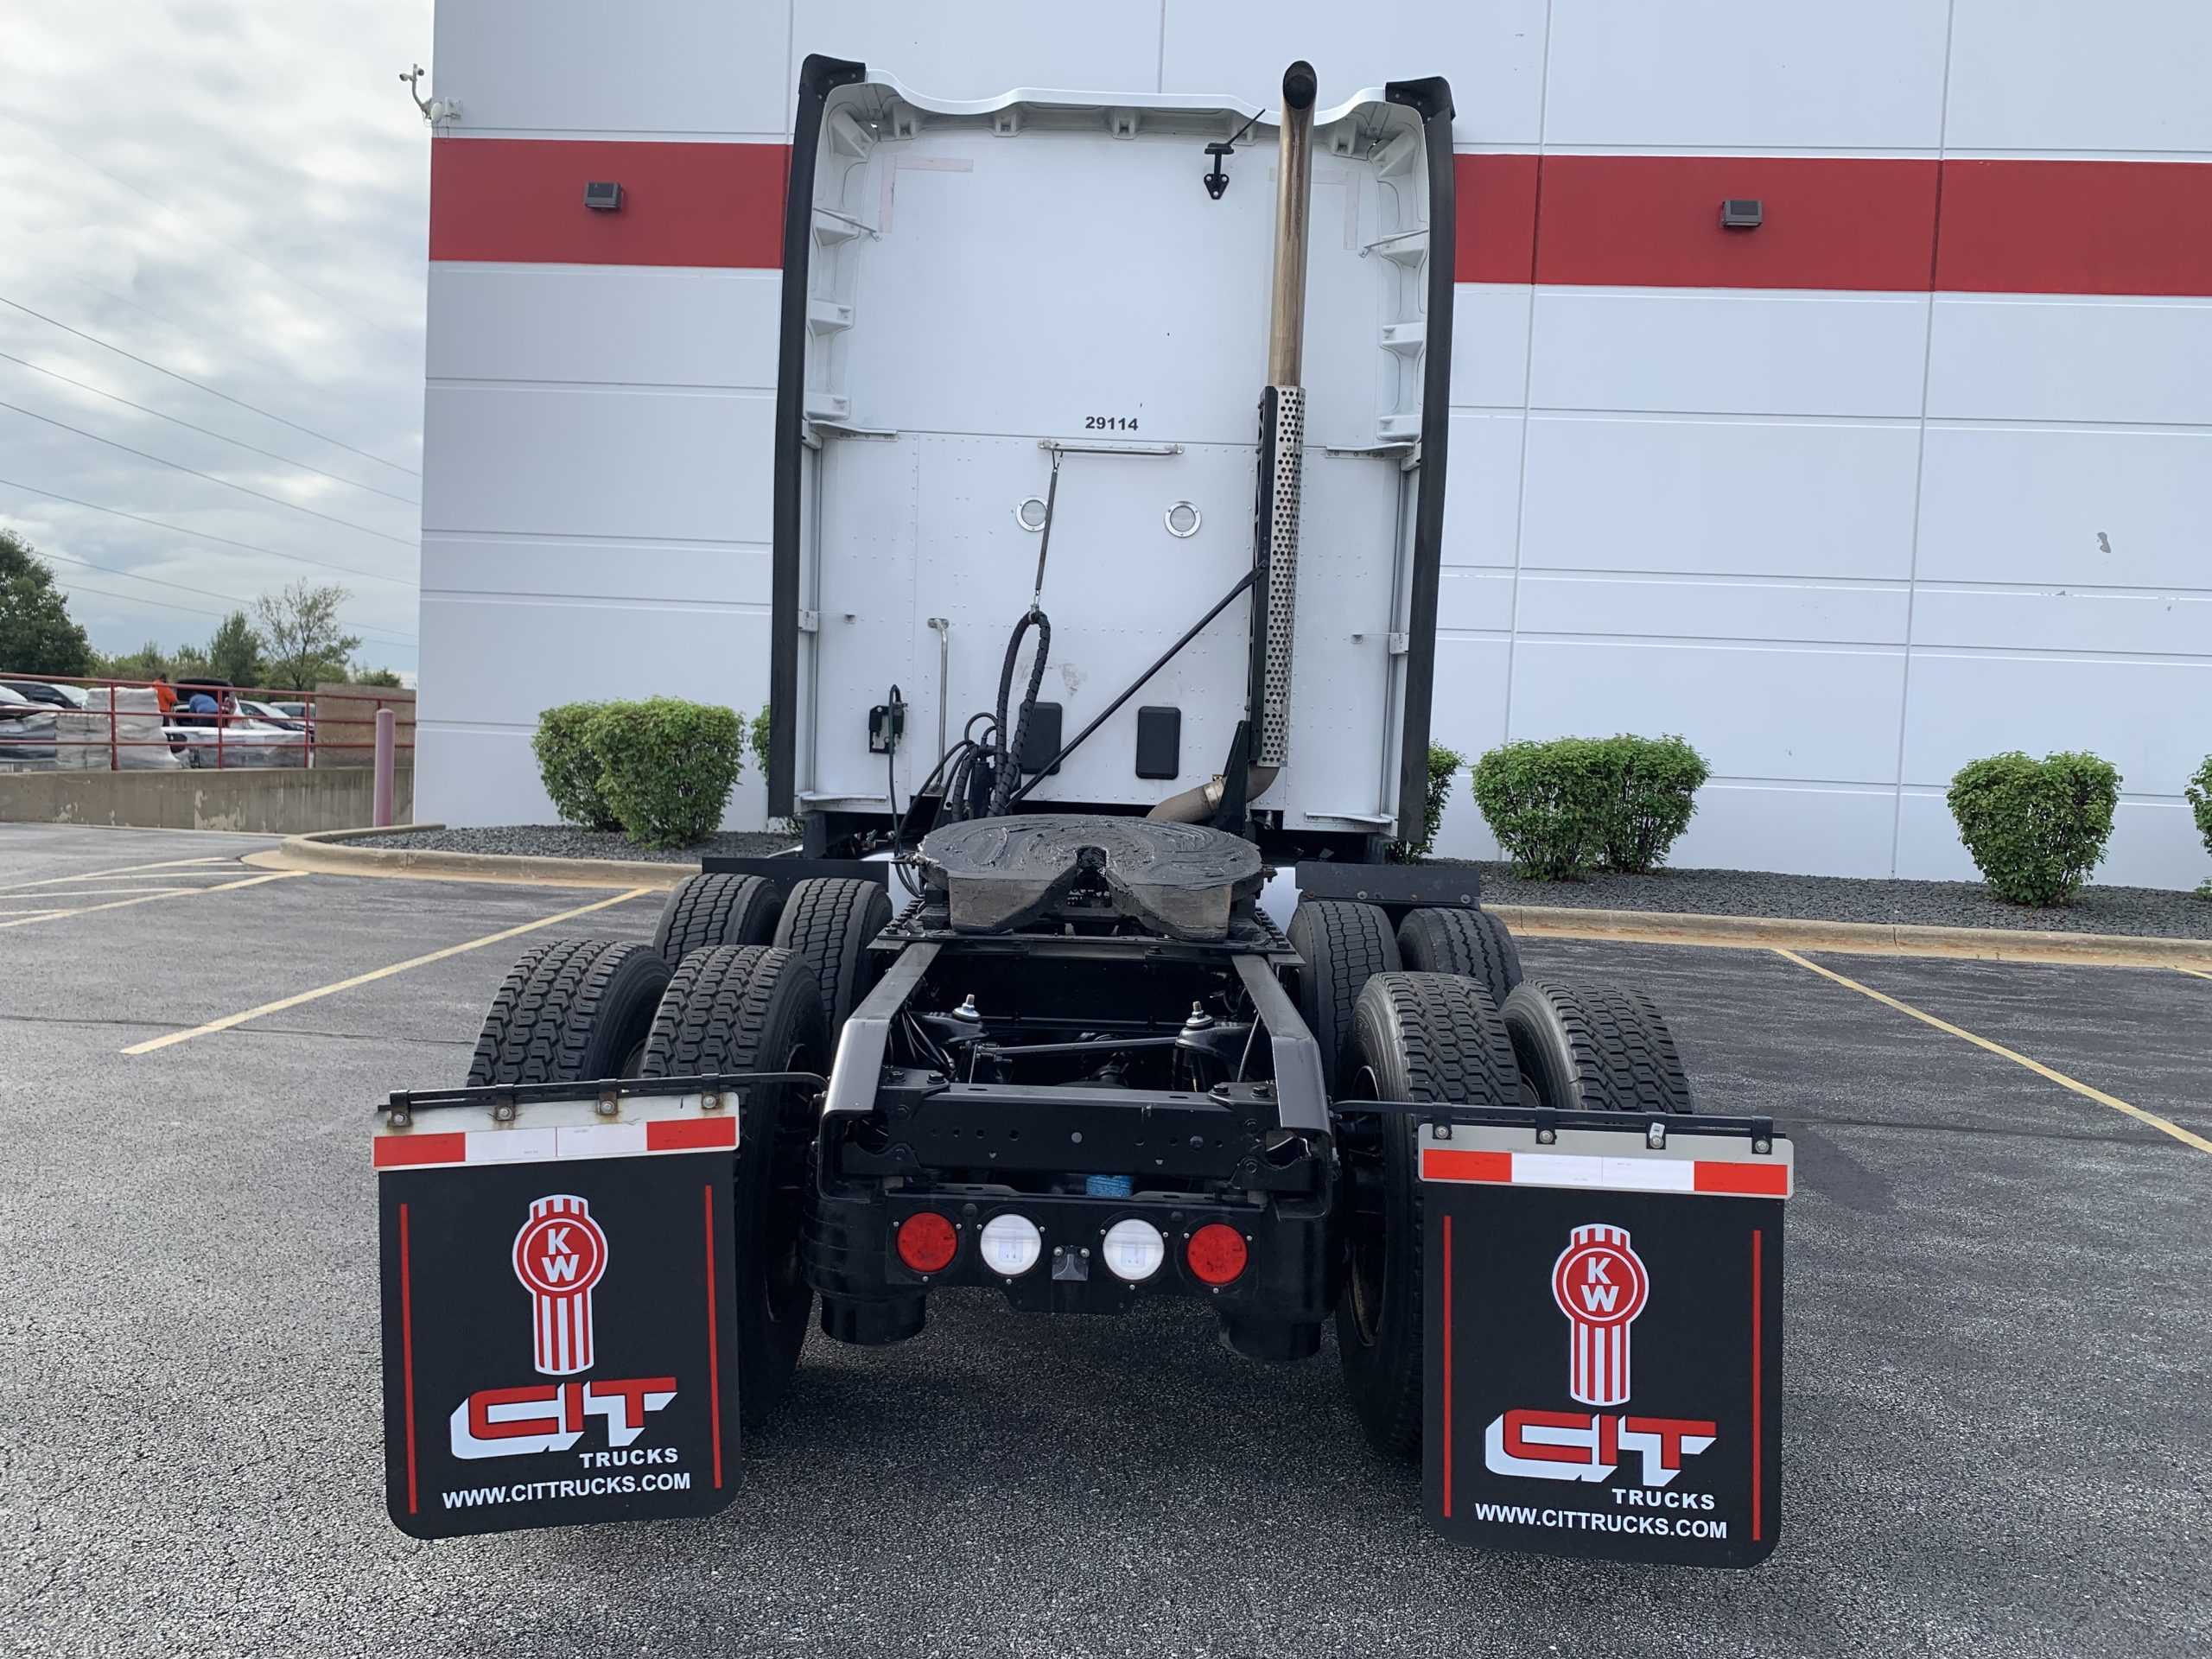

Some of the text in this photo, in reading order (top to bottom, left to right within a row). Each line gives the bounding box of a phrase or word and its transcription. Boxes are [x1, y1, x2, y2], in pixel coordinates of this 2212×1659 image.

[1085, 416, 1138, 430] 29114
[548, 1227, 571, 1255] K
[542, 1255, 579, 1283] W
[1587, 1256, 1611, 1285] K
[1581, 1284, 1619, 1313] W
[450, 1376, 677, 1459] CIT
[580, 1447, 677, 1469] TRUCKS
[1485, 1409, 1716, 1486] CIT
[442, 1472, 690, 1509] WWW.CITTRUCKS.COM
[1611, 1488, 1715, 1510] TRUCKS
[1475, 1503, 1727, 1539] WWW.CITTRUCKS.COM
